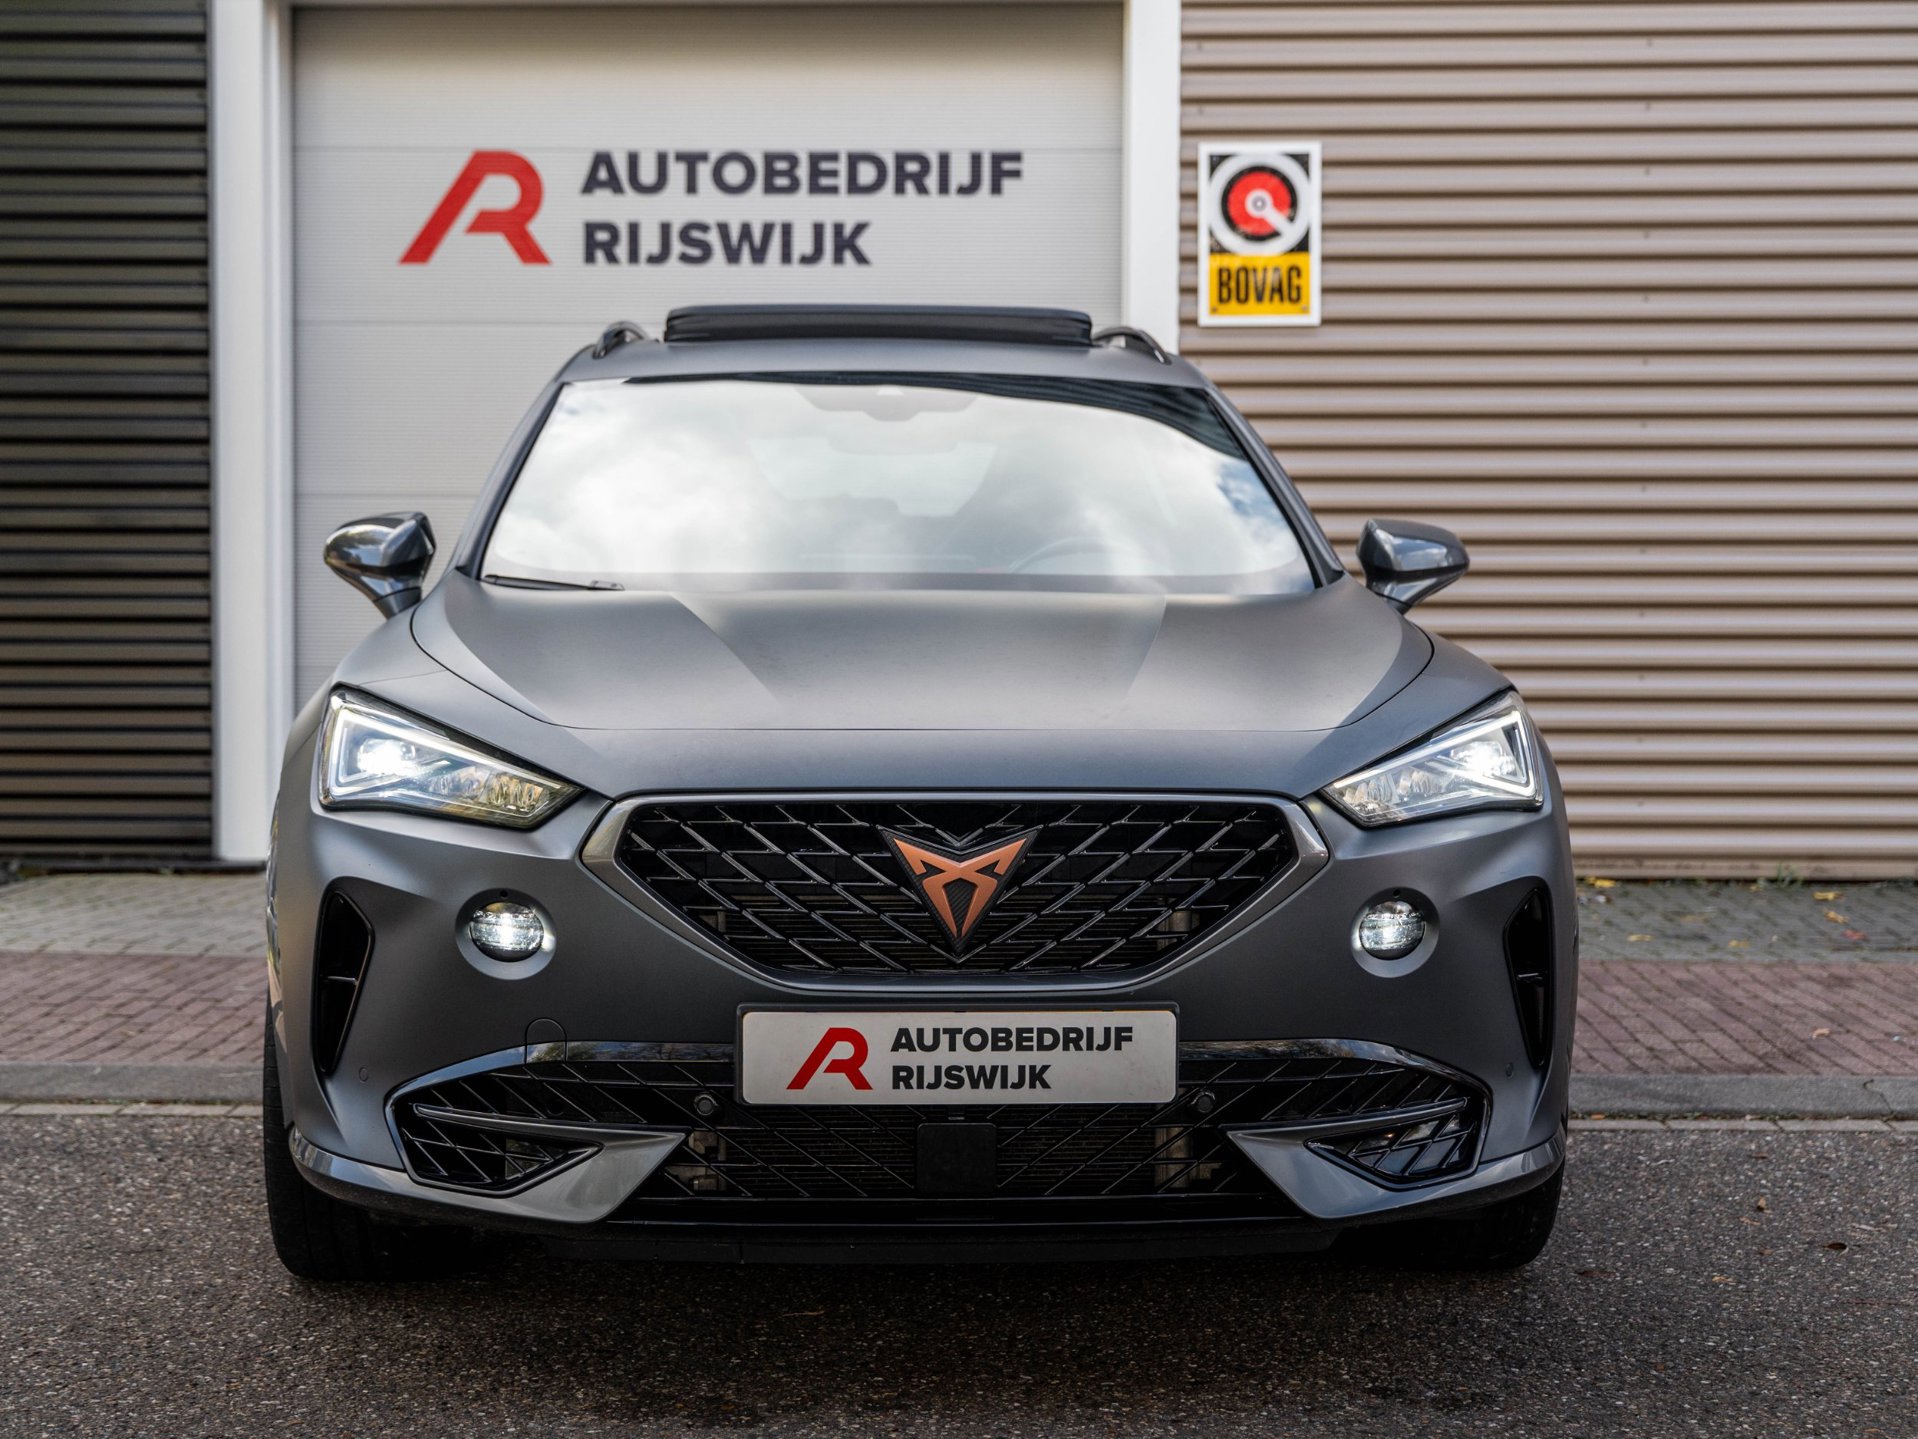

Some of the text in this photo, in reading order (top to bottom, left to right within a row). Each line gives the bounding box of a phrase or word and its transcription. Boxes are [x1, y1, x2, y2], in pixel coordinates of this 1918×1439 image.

[580, 151, 1022, 195] AUTOBEDRIJF
[584, 221, 872, 265] RIJSWIJK
[1218, 266, 1302, 304] BOVAG
[891, 1026, 1133, 1052] AUTOBEDRIJF
[892, 1064, 1051, 1090] RIJSWIJK
